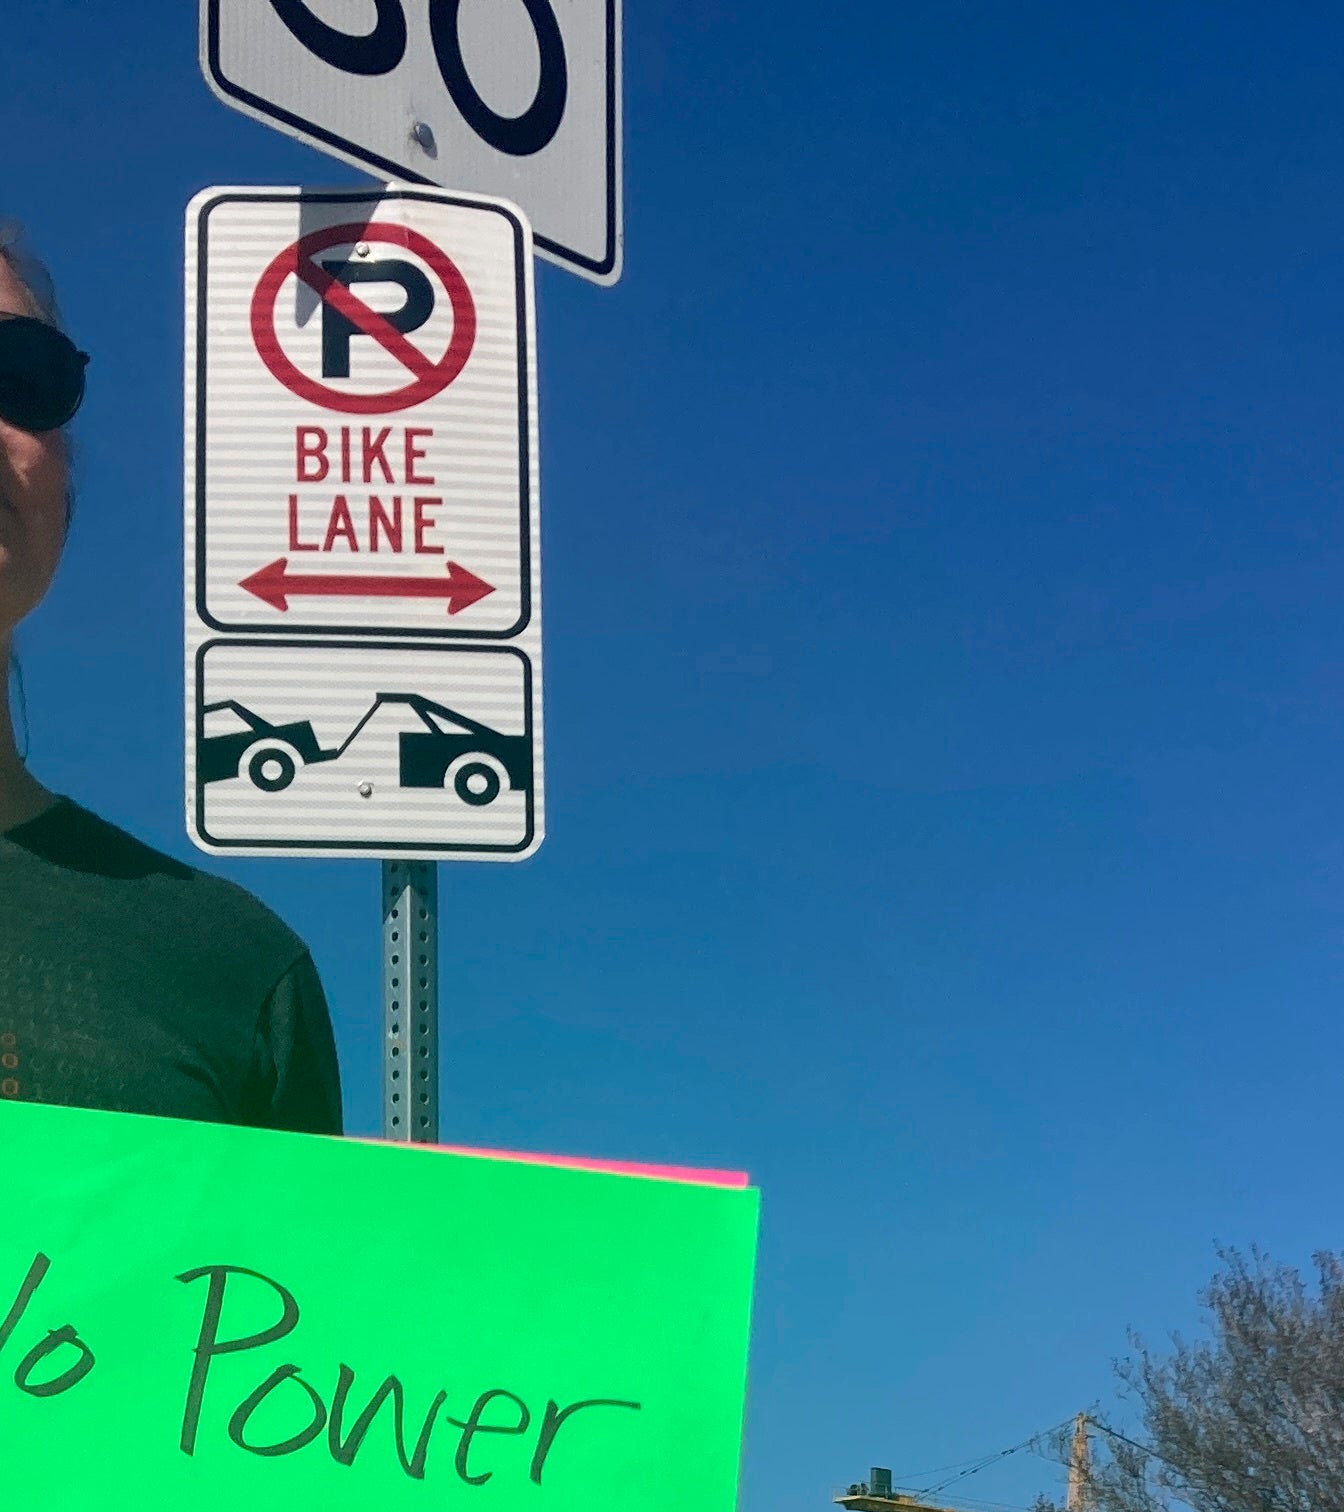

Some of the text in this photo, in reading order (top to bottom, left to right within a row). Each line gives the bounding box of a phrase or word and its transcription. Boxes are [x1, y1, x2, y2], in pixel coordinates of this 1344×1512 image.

[297, 427, 434, 485] BIKE
[289, 494, 444, 554] LANE
[176, 1265, 641, 1486] Power
